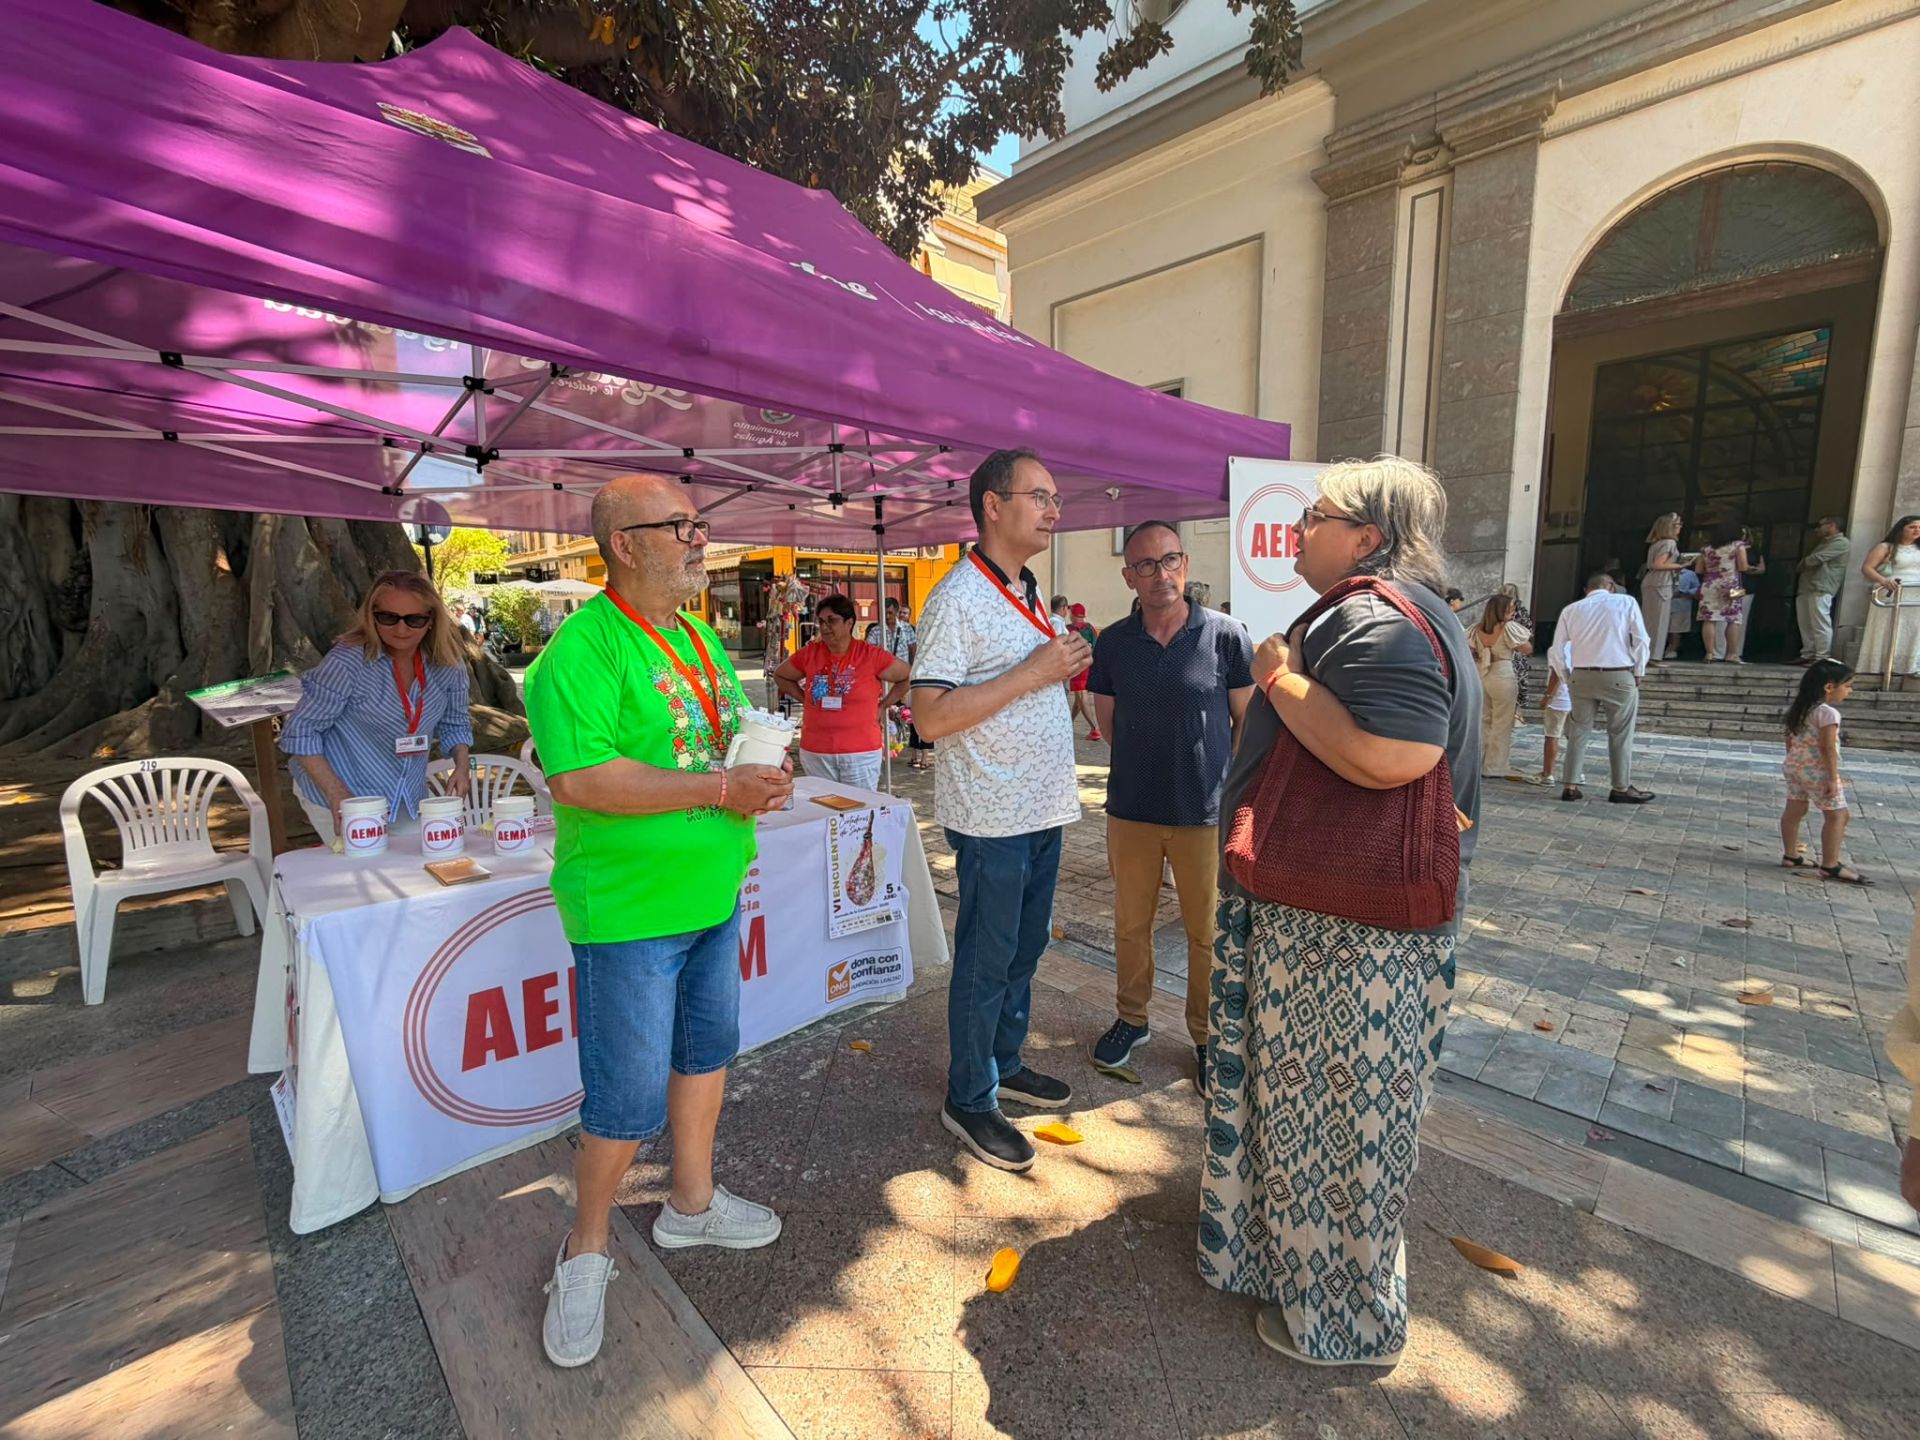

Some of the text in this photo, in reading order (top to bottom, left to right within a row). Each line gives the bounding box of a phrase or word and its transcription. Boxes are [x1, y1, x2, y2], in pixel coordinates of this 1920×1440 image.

[140, 760, 158, 772] 219
[829, 817, 841, 913] VI ENCUENTRO
[744, 878, 760, 895] de
[886, 883, 894, 894] 5
[740, 900, 760, 913] cia
[850, 953, 899, 970] dona con
[850, 963, 902, 981] confianza
[830, 981, 848, 994] ONG
[462, 966, 578, 1072] AE
